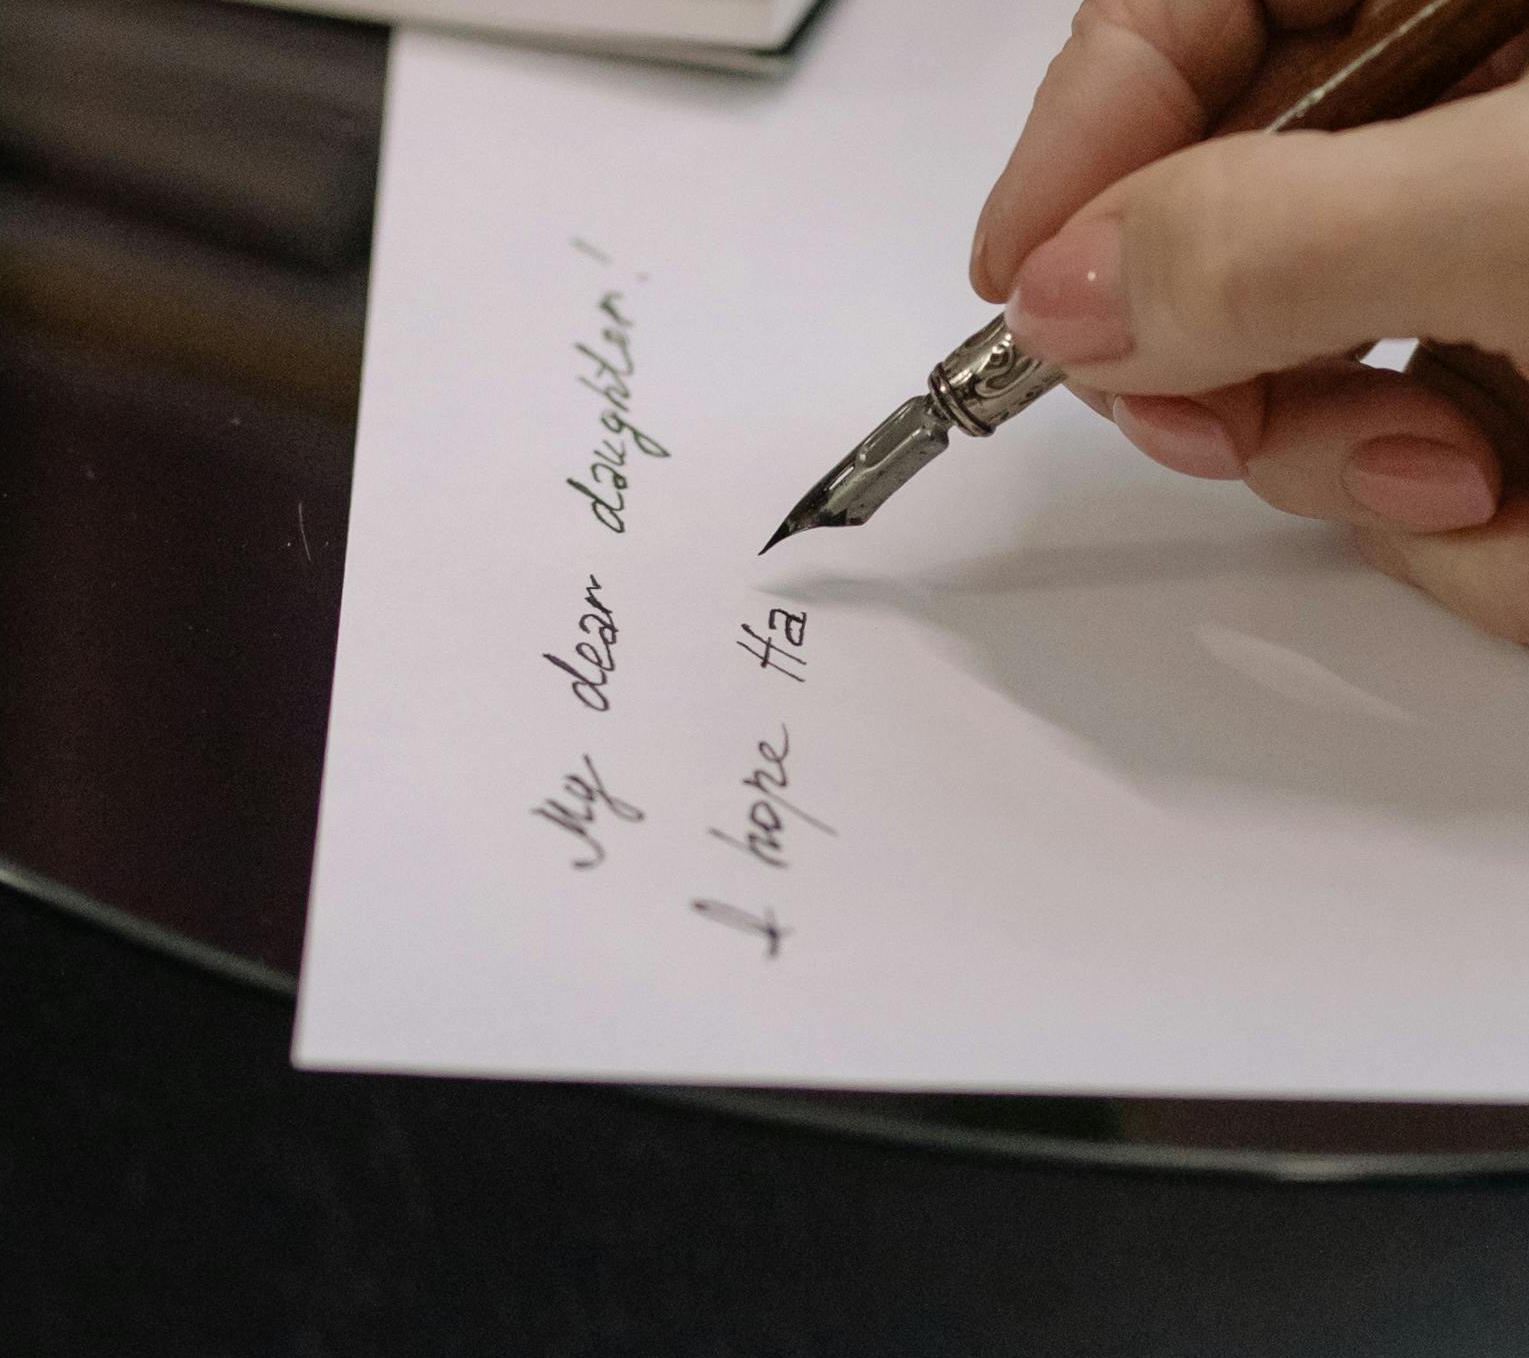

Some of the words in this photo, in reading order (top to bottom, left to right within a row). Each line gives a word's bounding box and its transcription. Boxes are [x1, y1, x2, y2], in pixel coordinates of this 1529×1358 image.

[568, 237, 672, 535] daughter!
[542, 573, 620, 713] dear
[735, 605, 809, 685] Ha
[532, 753, 645, 872] My
[708, 724, 839, 871] hope
[689, 896, 795, 961] I
